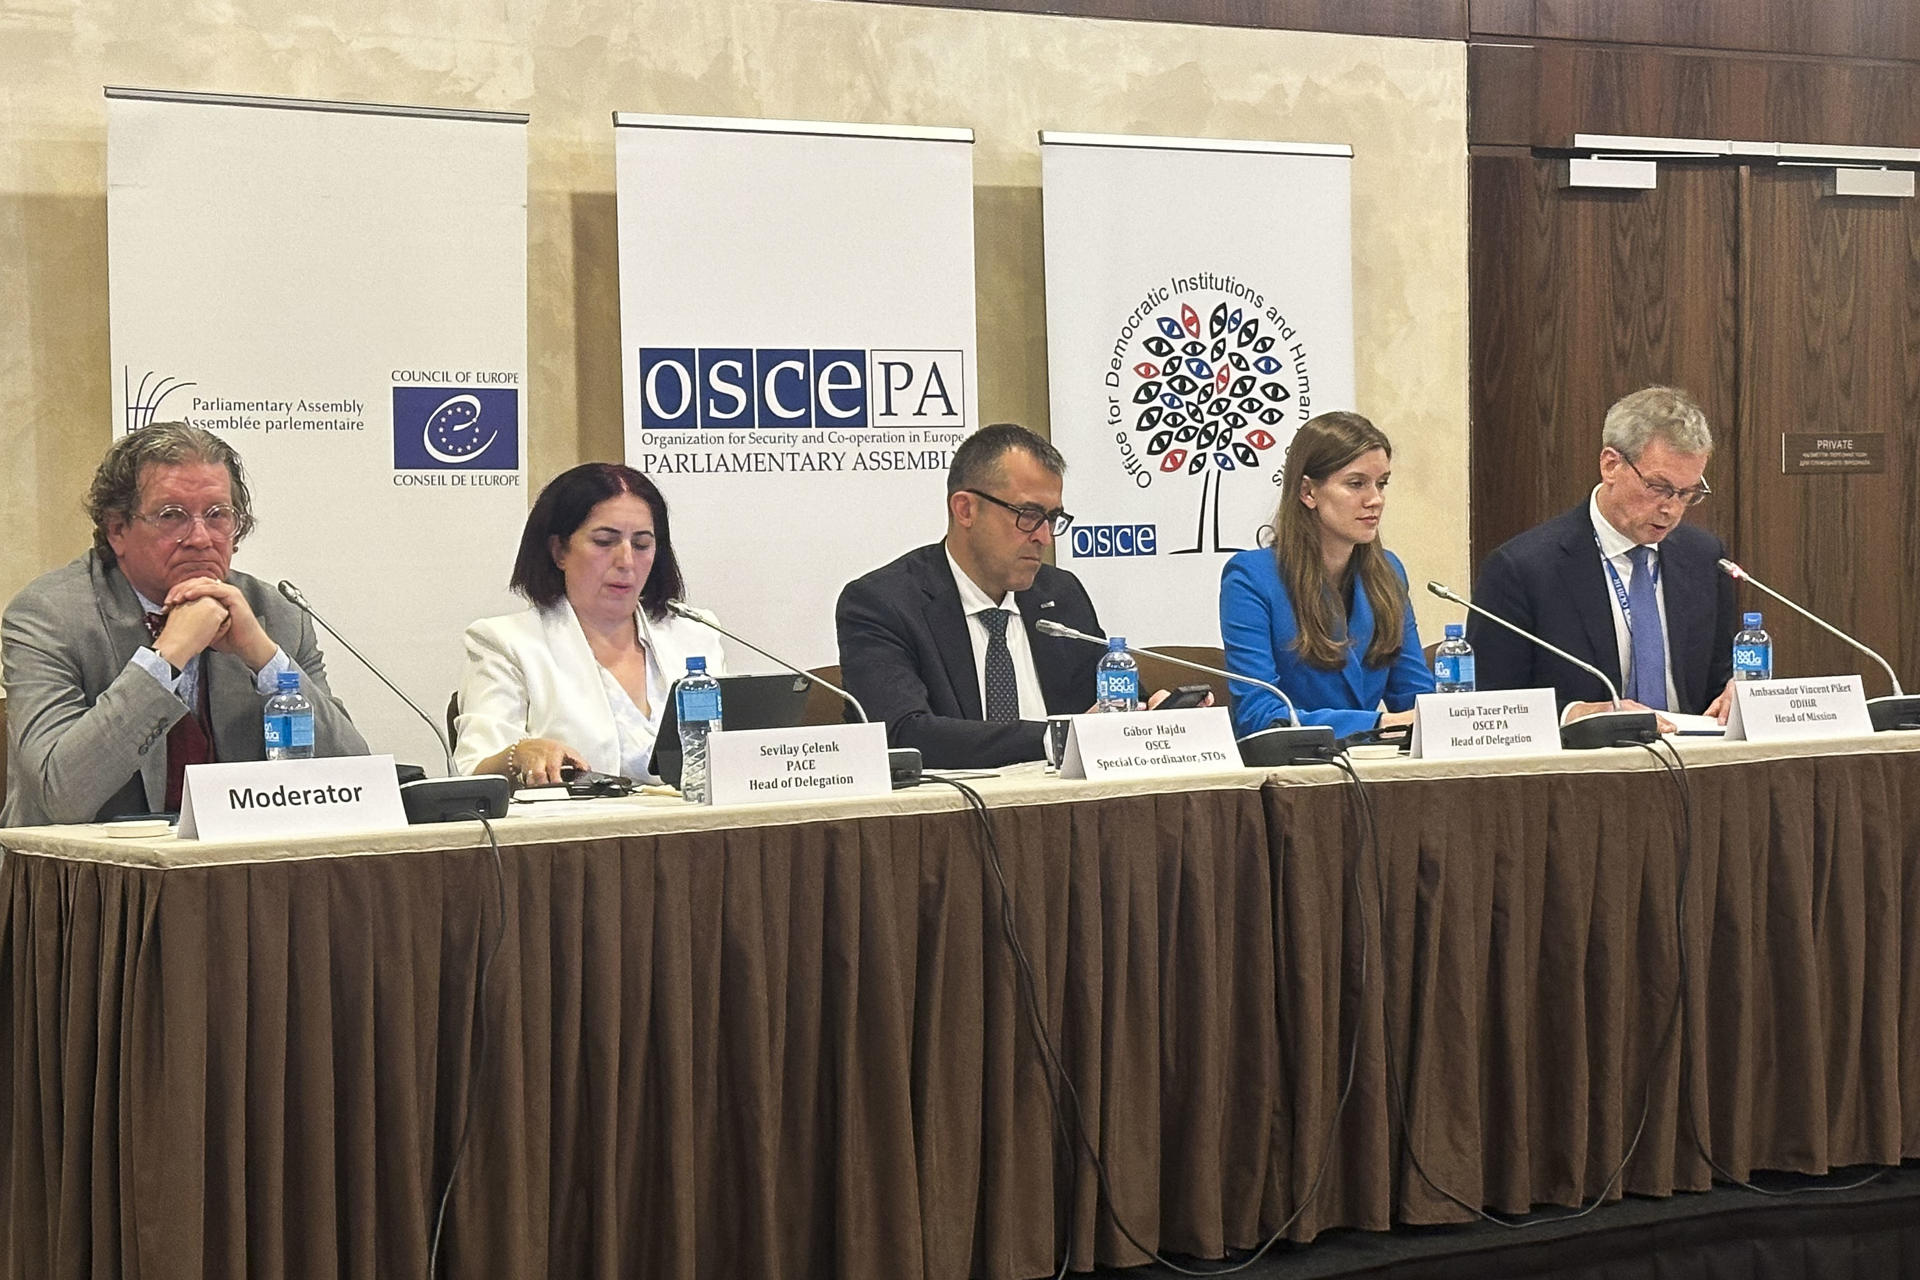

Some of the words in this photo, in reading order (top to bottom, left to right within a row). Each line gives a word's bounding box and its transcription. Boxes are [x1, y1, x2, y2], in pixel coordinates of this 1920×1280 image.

[1171, 272, 1264, 309] Institutions
[1266, 306, 1296, 341] and
[1106, 287, 1170, 388] Democratic
[392, 370, 451, 382] COUNCIL
[456, 372, 471, 382] OF
[477, 372, 518, 383] EUROPE
[1290, 344, 1312, 421] Human
[878, 362, 958, 416] PA
[194, 398, 292, 415] Parliamentary
[297, 400, 363, 416] Assembly
[1108, 396, 1122, 425] for
[266, 415, 364, 433] parlementaire
[642, 433, 724, 449] Organization
[729, 433, 745, 444] for
[749, 432, 798, 447] Security
[802, 432, 824, 443] and
[828, 432, 905, 447] Co-operation
[908, 431, 920, 443] in
[924, 431, 964, 446] Europe
[1816, 440, 1854, 450] PRIVATE
[643, 452, 845, 474] PARLIAMENTARY
[852, 451, 955, 471] ASSEMBL
[1116, 432, 1153, 488] Office
[394, 475, 447, 486] CONSEIL
[452, 475, 466, 486] DE
[471, 475, 519, 486] L'EUROPE
[1749, 684, 1799, 697] Ambassador
[1799, 686, 1831, 695] Vincent
[1830, 682, 1852, 693] Piket
[1448, 706, 1476, 719] Lucija
[1475, 706, 1502, 716] Tacer
[1502, 703, 1529, 715] Perlin
[1789, 699, 1818, 709] ODIHR
[1472, 721, 1495, 731] OSCE
[1496, 720, 1509, 730] PA
[1774, 713, 1797, 723] Head
[1796, 713, 1806, 722] of
[1805, 712, 1838, 721] Mission
[1123, 723, 1153, 737] Gábor
[1156, 724, 1186, 737] Hajdu
[1144, 740, 1172, 751] OSCE
[1450, 736, 1474, 747] Head
[1475, 736, 1485, 746] of
[1485, 733, 1532, 747] Delegation
[760, 742, 800, 758] Sevilay
[801, 741, 840, 757] Çelenk
[786, 760, 816, 772] PACE
[1096, 757, 1133, 771] Special
[1200, 752, 1227, 762] STOs
[749, 778, 778, 791] Head
[780, 777, 793, 789] of
[794, 774, 854, 789] Delegation
[229, 785, 362, 809] Moderator
